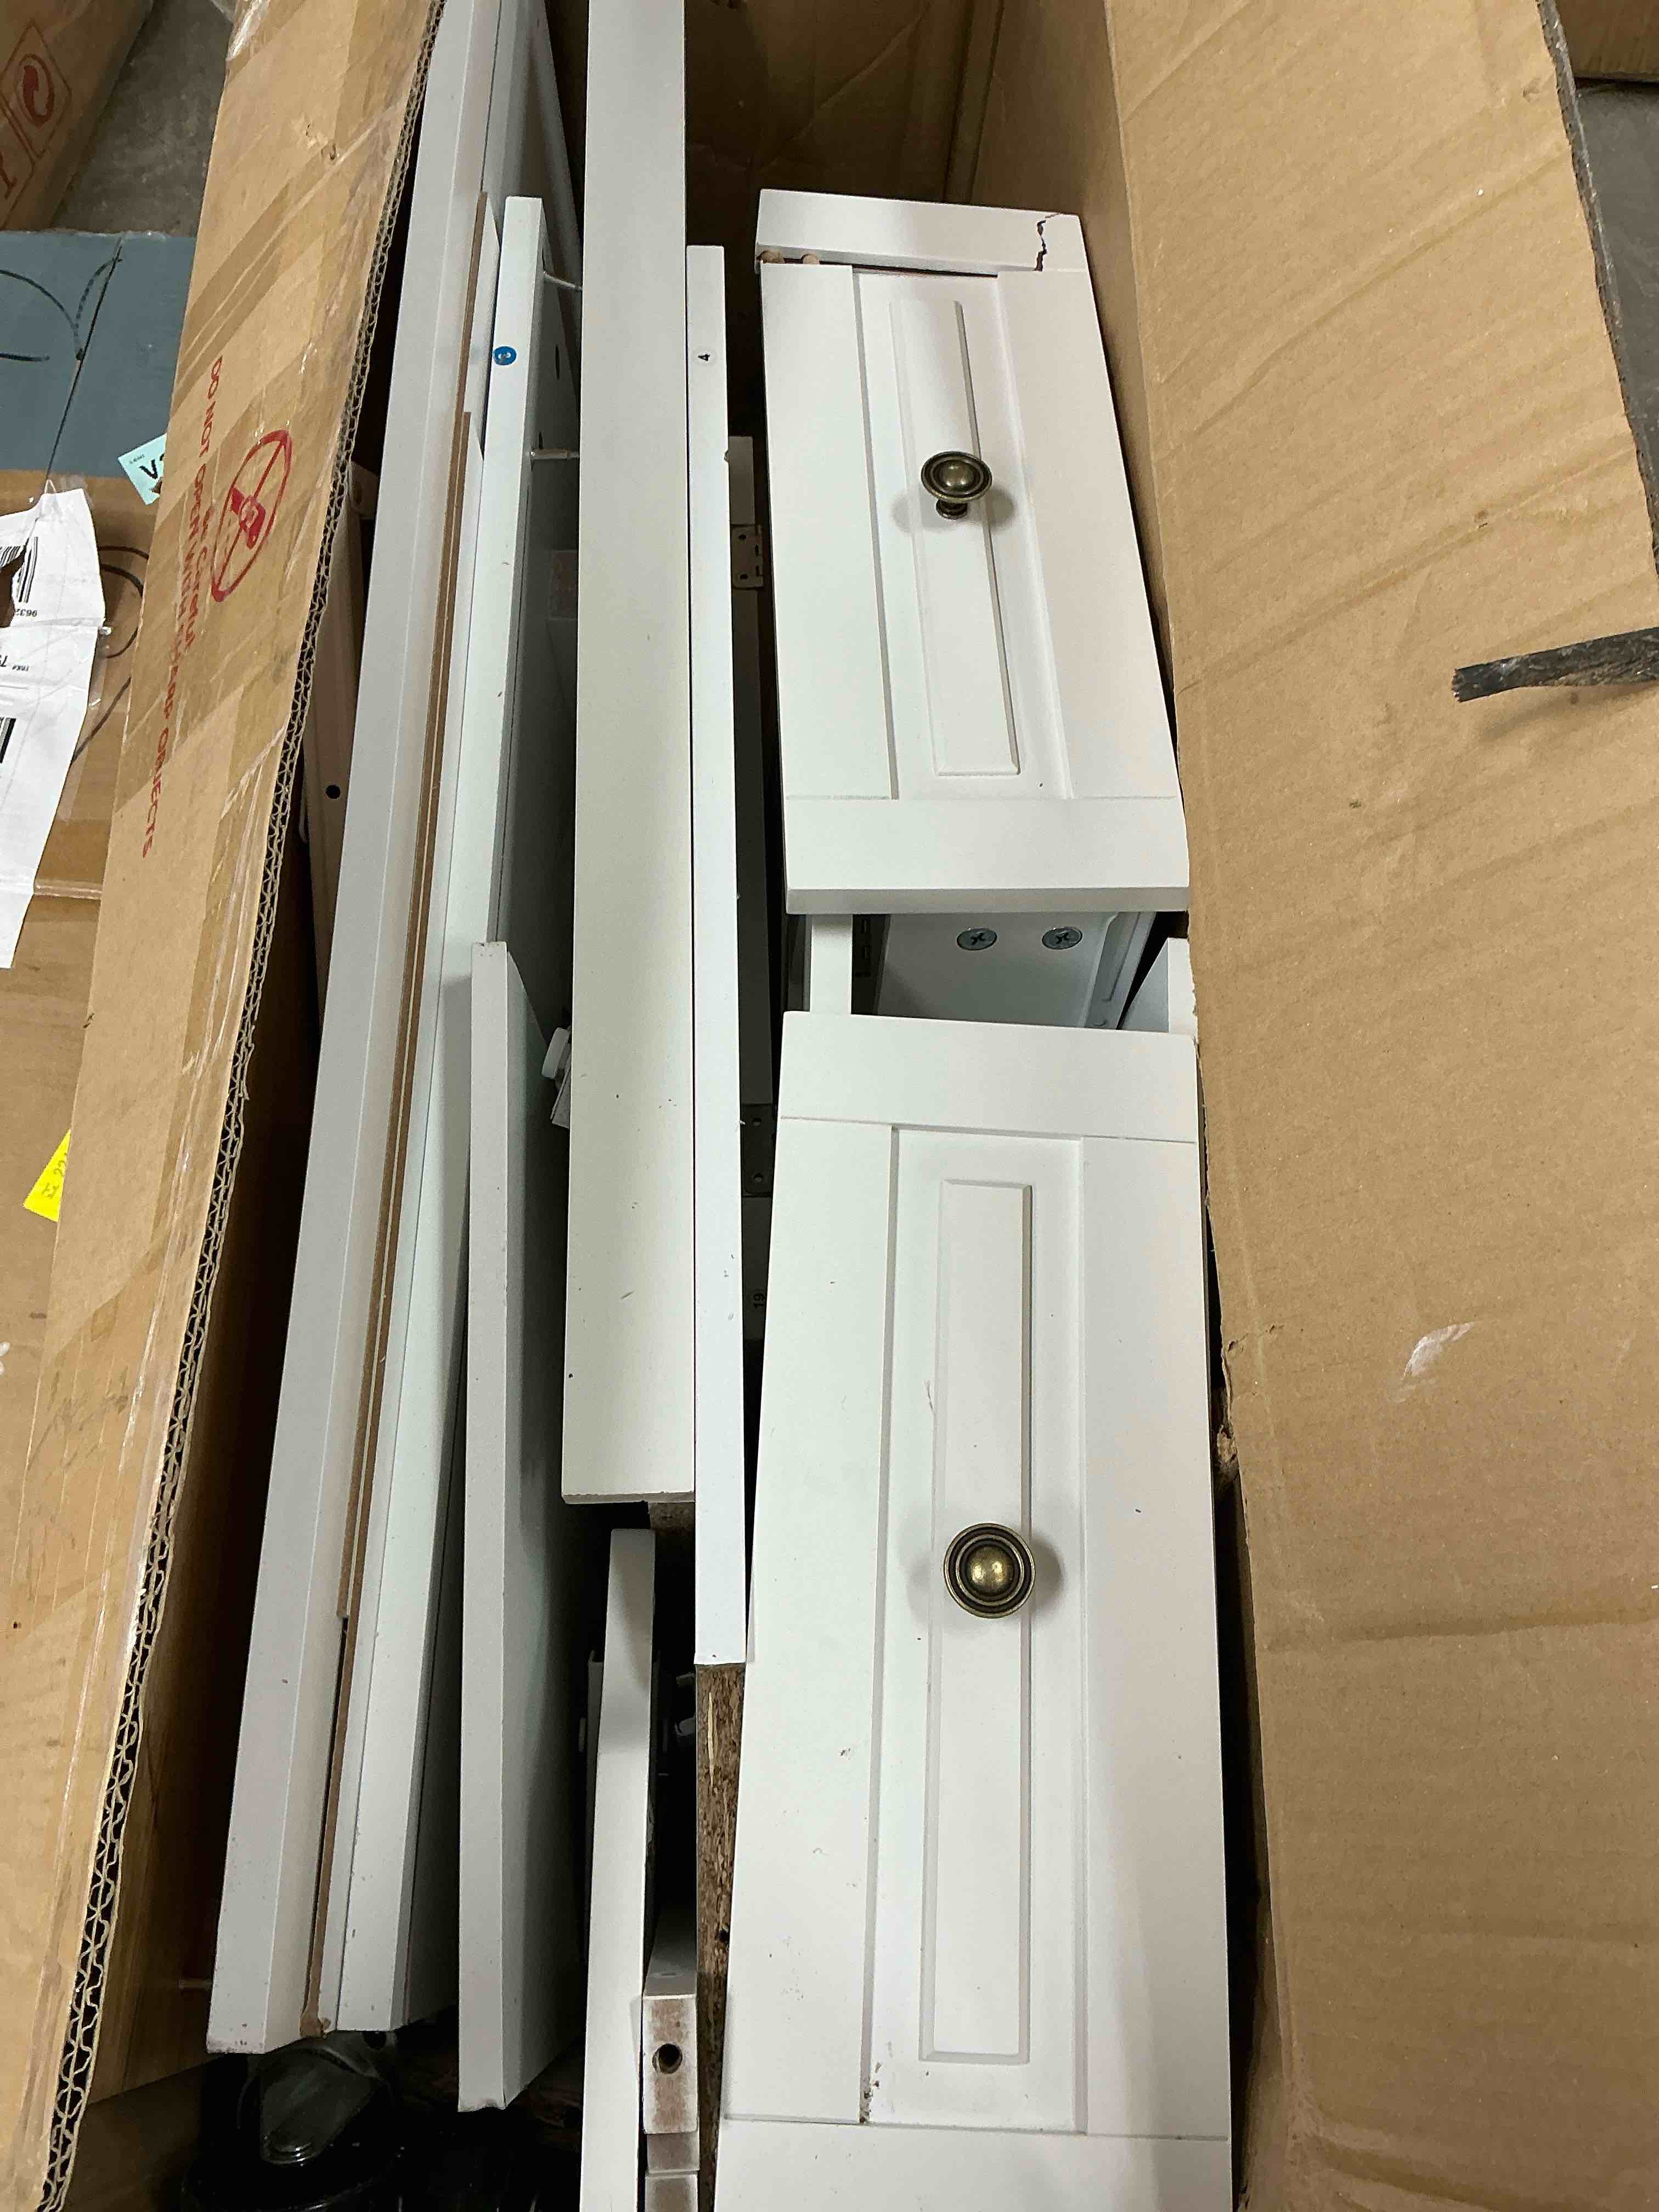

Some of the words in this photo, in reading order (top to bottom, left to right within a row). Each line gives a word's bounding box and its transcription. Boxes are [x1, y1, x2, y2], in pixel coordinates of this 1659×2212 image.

[208, 355, 223, 400] DO
[697, 353, 711, 362] 4
[199, 400, 216, 457] NOT
[189, 463, 206, 541] OPEN
[143, 727, 169, 859] OBJECTS
